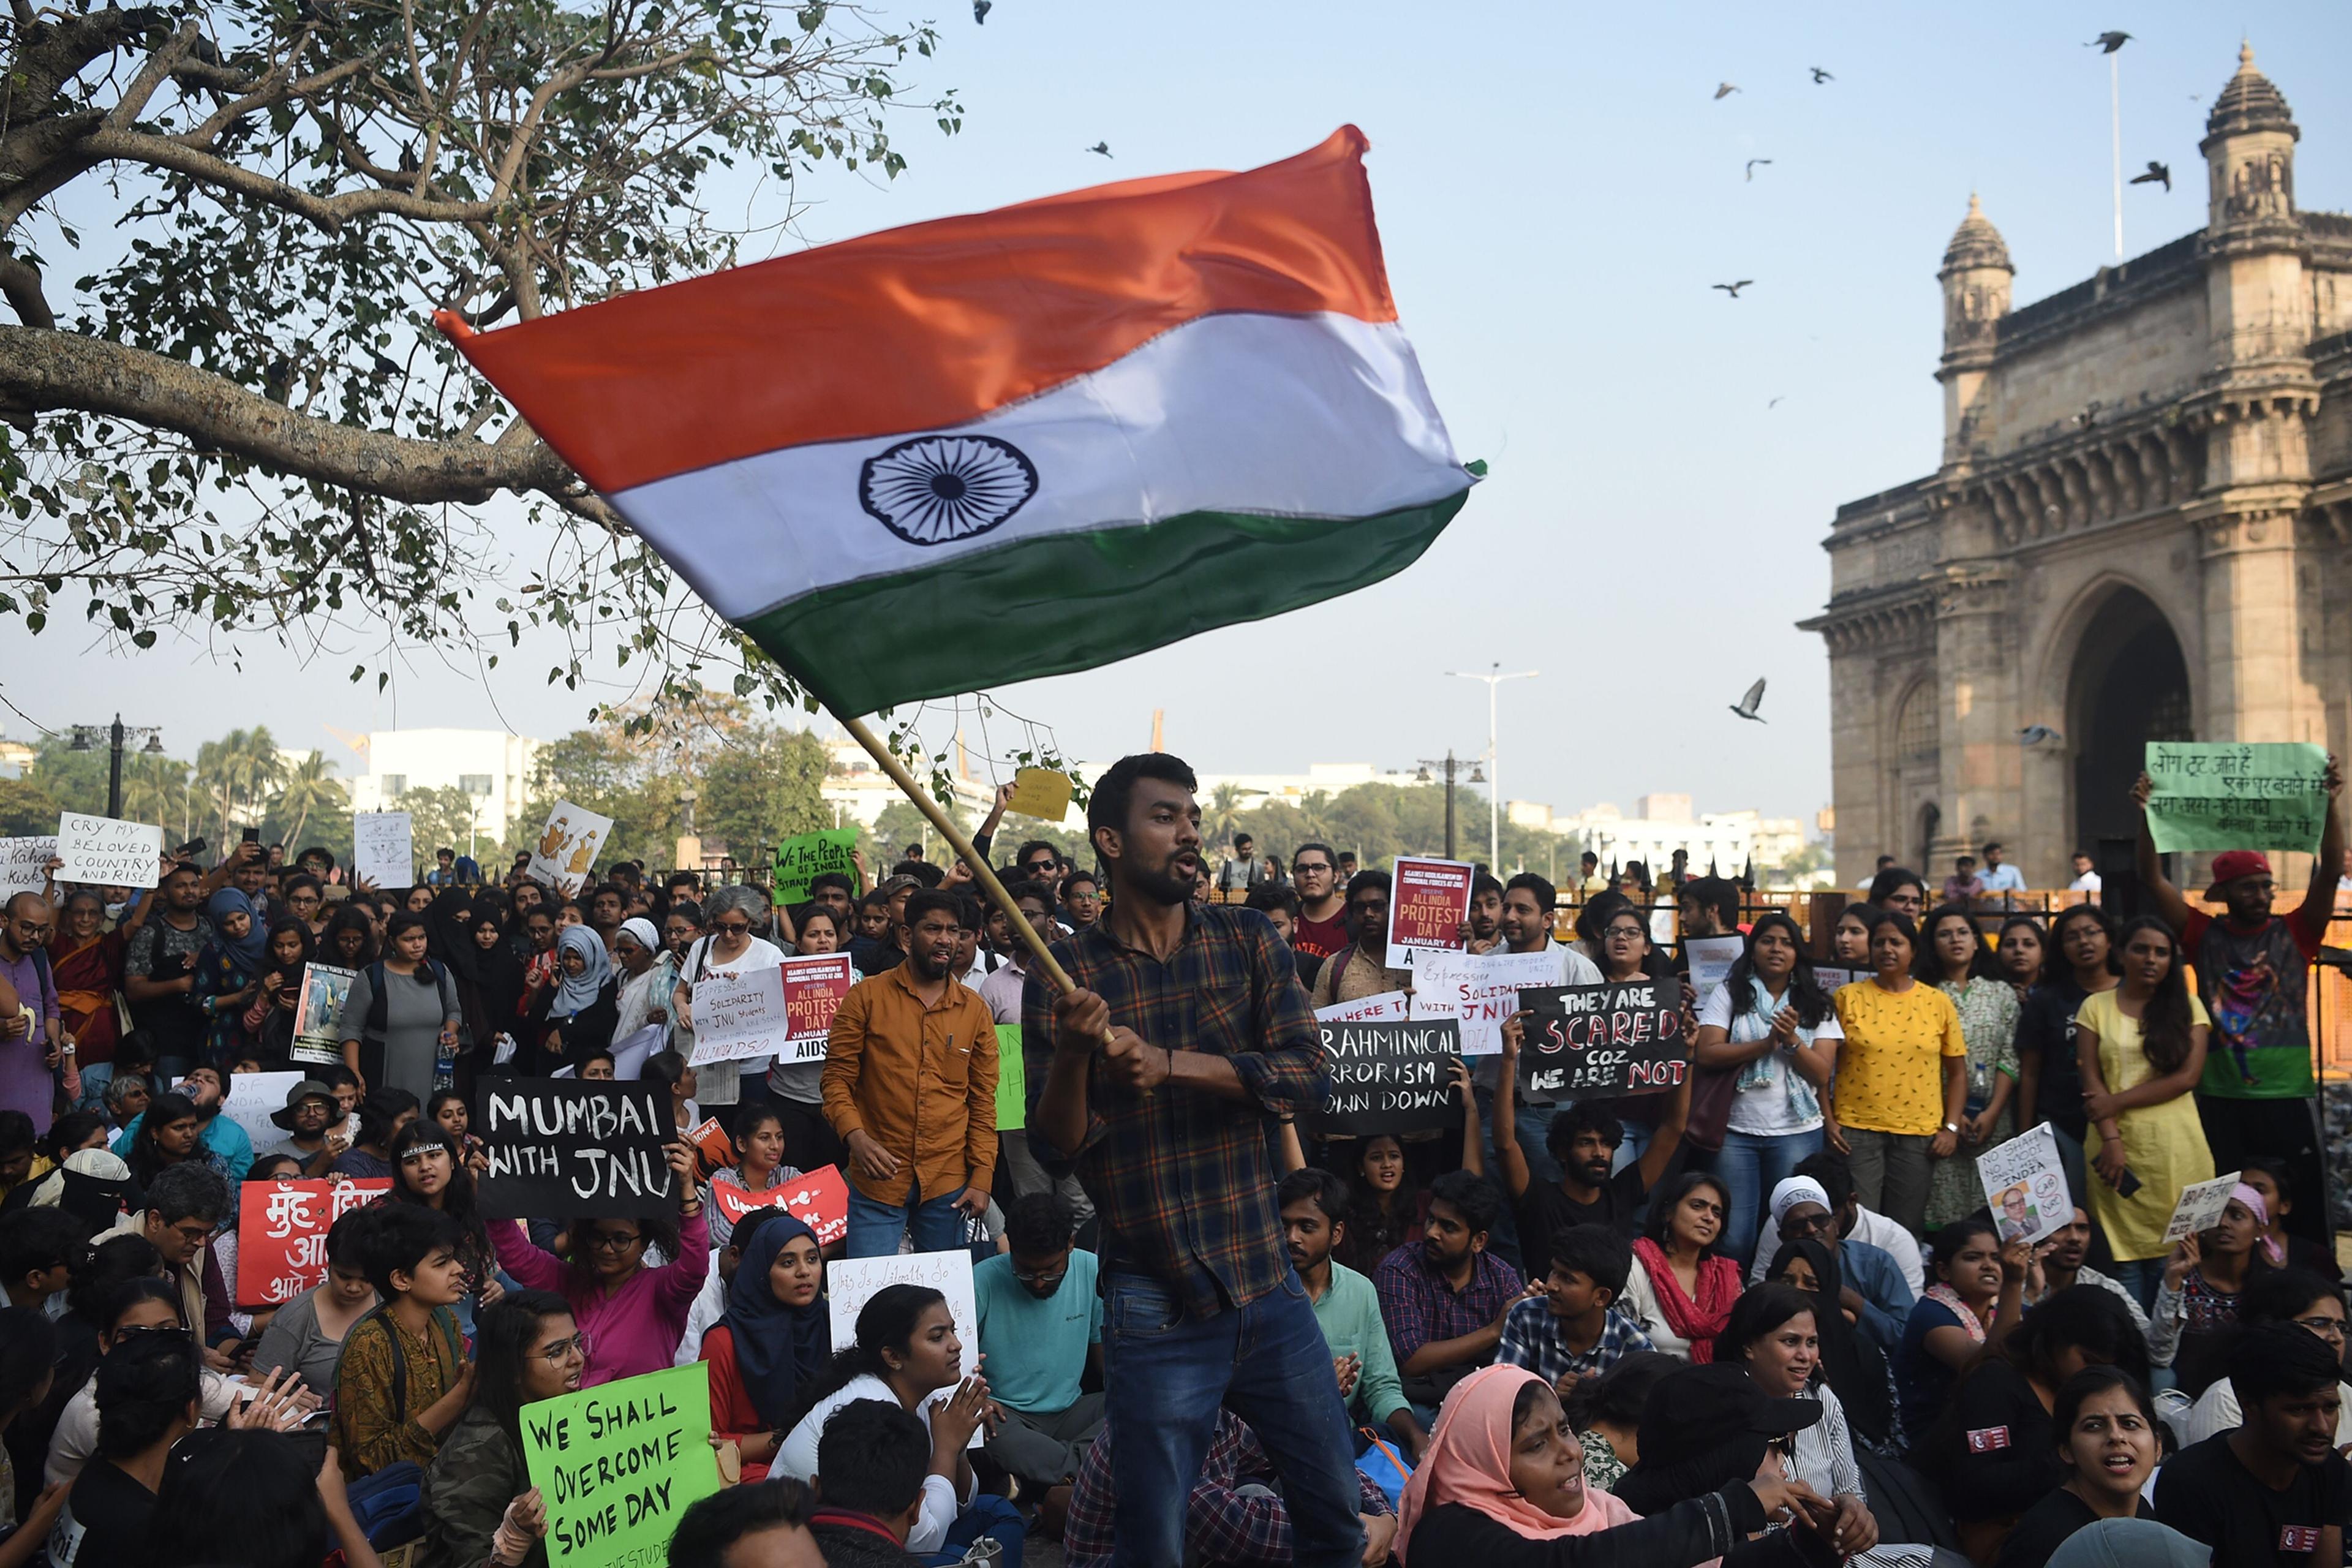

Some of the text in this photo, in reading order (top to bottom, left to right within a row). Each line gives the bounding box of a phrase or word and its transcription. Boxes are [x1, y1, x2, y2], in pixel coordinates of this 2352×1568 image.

[71, 820, 140, 839] CRY MY
[71, 839, 151, 853] BELOVED
[798, 846, 816, 864] THE
[818, 839, 852, 861] PEOPLE
[74, 856, 155, 872] COUNTRY
[797, 860, 846, 873] OF INDIA
[81, 870, 154, 885] AND RISE!
[778, 877, 809, 891] STAND
[1412, 894, 1451, 907] ALL INDIA
[1400, 904, 1461, 924] PROTEST
[1417, 922, 1442, 938] DAY
[1401, 937, 1446, 948] JANUARY
[710, 990, 764, 1011] SOLIDARITY
[797, 987, 834, 1000] ALL INDIA
[1559, 987, 1656, 1015] THEY ARE
[712, 1012, 735, 1028] JNU
[1345, 1005, 1384, 1022] HERE
[1391, 1000, 1409, 1013] T
[1420, 1000, 1513, 1020] WITH JNU
[805, 1014, 827, 1030] DAY
[1538, 1009, 1678, 1054] SCARED
[791, 1029, 830, 1040] JANUAR
[1321, 1028, 1461, 1058] RAHMINICAL
[734, 1038, 770, 1055] DSO
[796, 1040, 829, 1058] AIDS
[1586, 1050, 1629, 1066] COZ
[1330, 1061, 1435, 1085] RRORISM
[1531, 1060, 1687, 1091] WE ARE NOT
[238, 1079, 263, 1092] OF
[1323, 1089, 1449, 1114] OWN DOWN
[489, 1092, 660, 1140] MUMBAI
[1982, 1134, 2038, 1165] NO SHAH
[1985, 1144, 2043, 1177] NO MODI
[489, 1144, 560, 1178] WITH
[571, 1146, 671, 1199] JNU
[2003, 1161, 2046, 1187] INDIA
[1781, 1197, 1793, 1212] NO
[831, 1262, 854, 1298] This
[858, 1263, 872, 1289] Is
[931, 1257, 949, 1283] So
[529, 1392, 677, 1451] WE SHALL
[554, 1428, 683, 1504] OVERCOME
[555, 1477, 672, 1555] SOME DAY
[628, 1539, 668, 1568] STUDE
